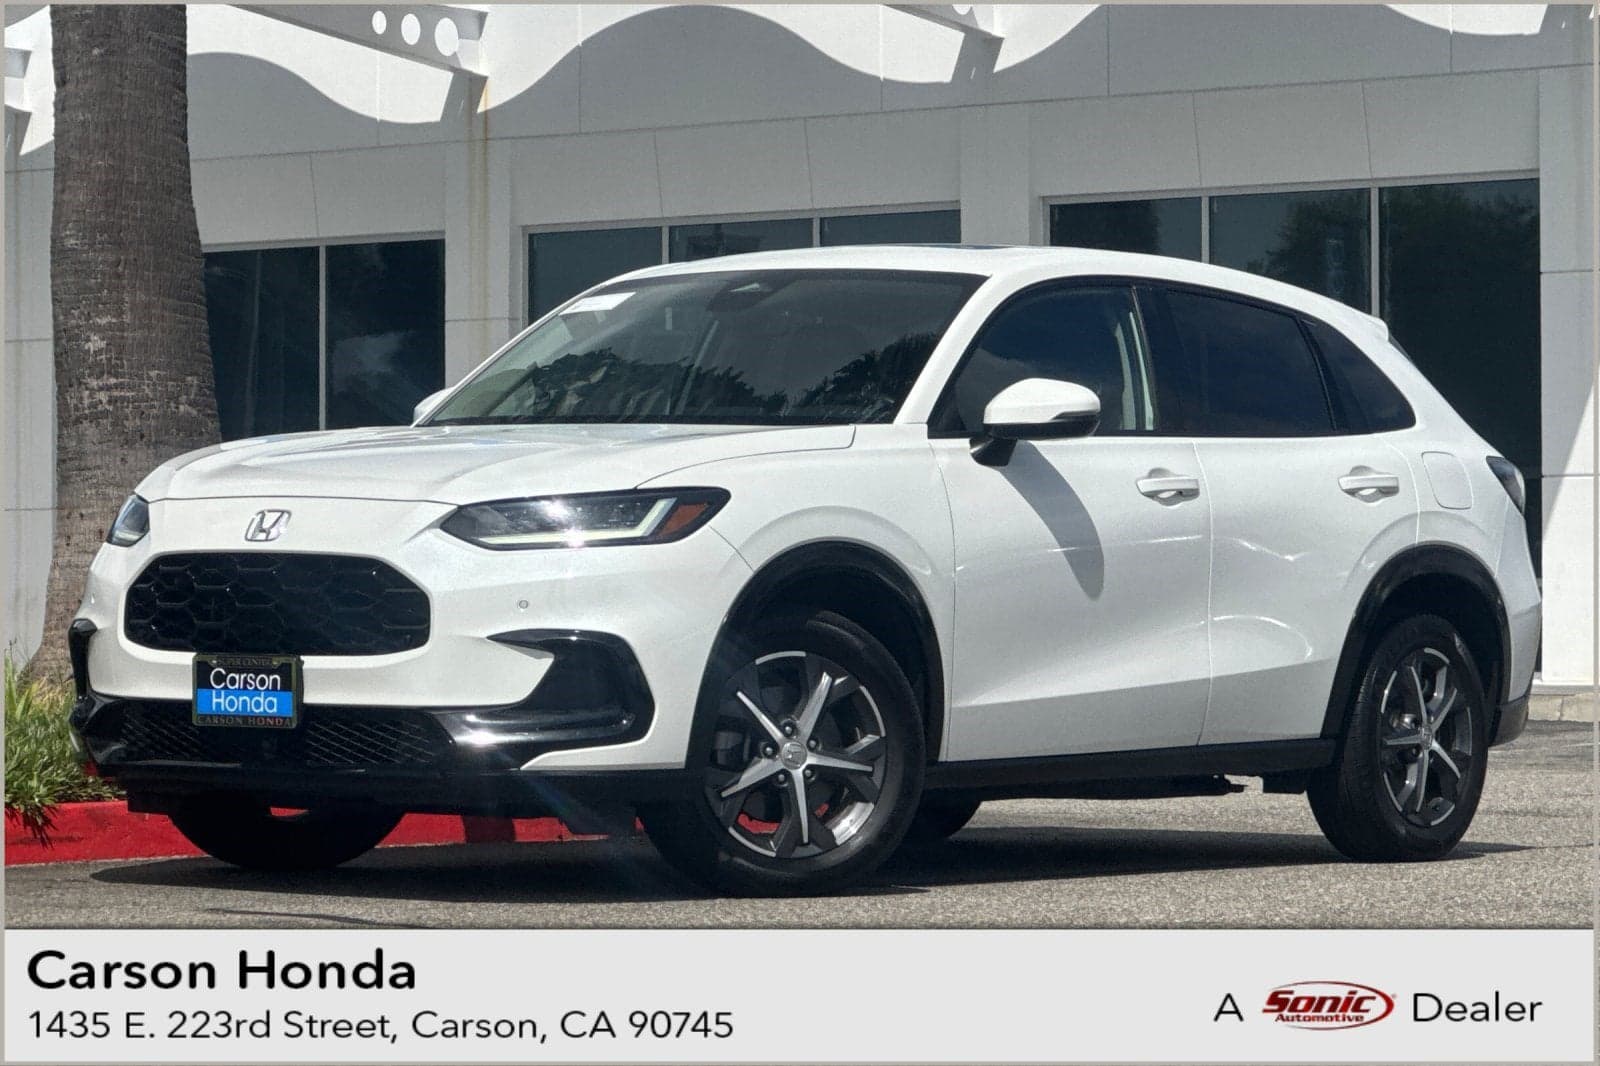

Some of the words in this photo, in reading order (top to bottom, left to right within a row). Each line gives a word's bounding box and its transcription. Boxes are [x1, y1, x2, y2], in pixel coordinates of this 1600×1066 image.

[210, 668, 281, 690] Carson
[212, 691, 278, 713] Honda
[197, 715, 243, 725] CARSON
[248, 717, 292, 727] HONDA
